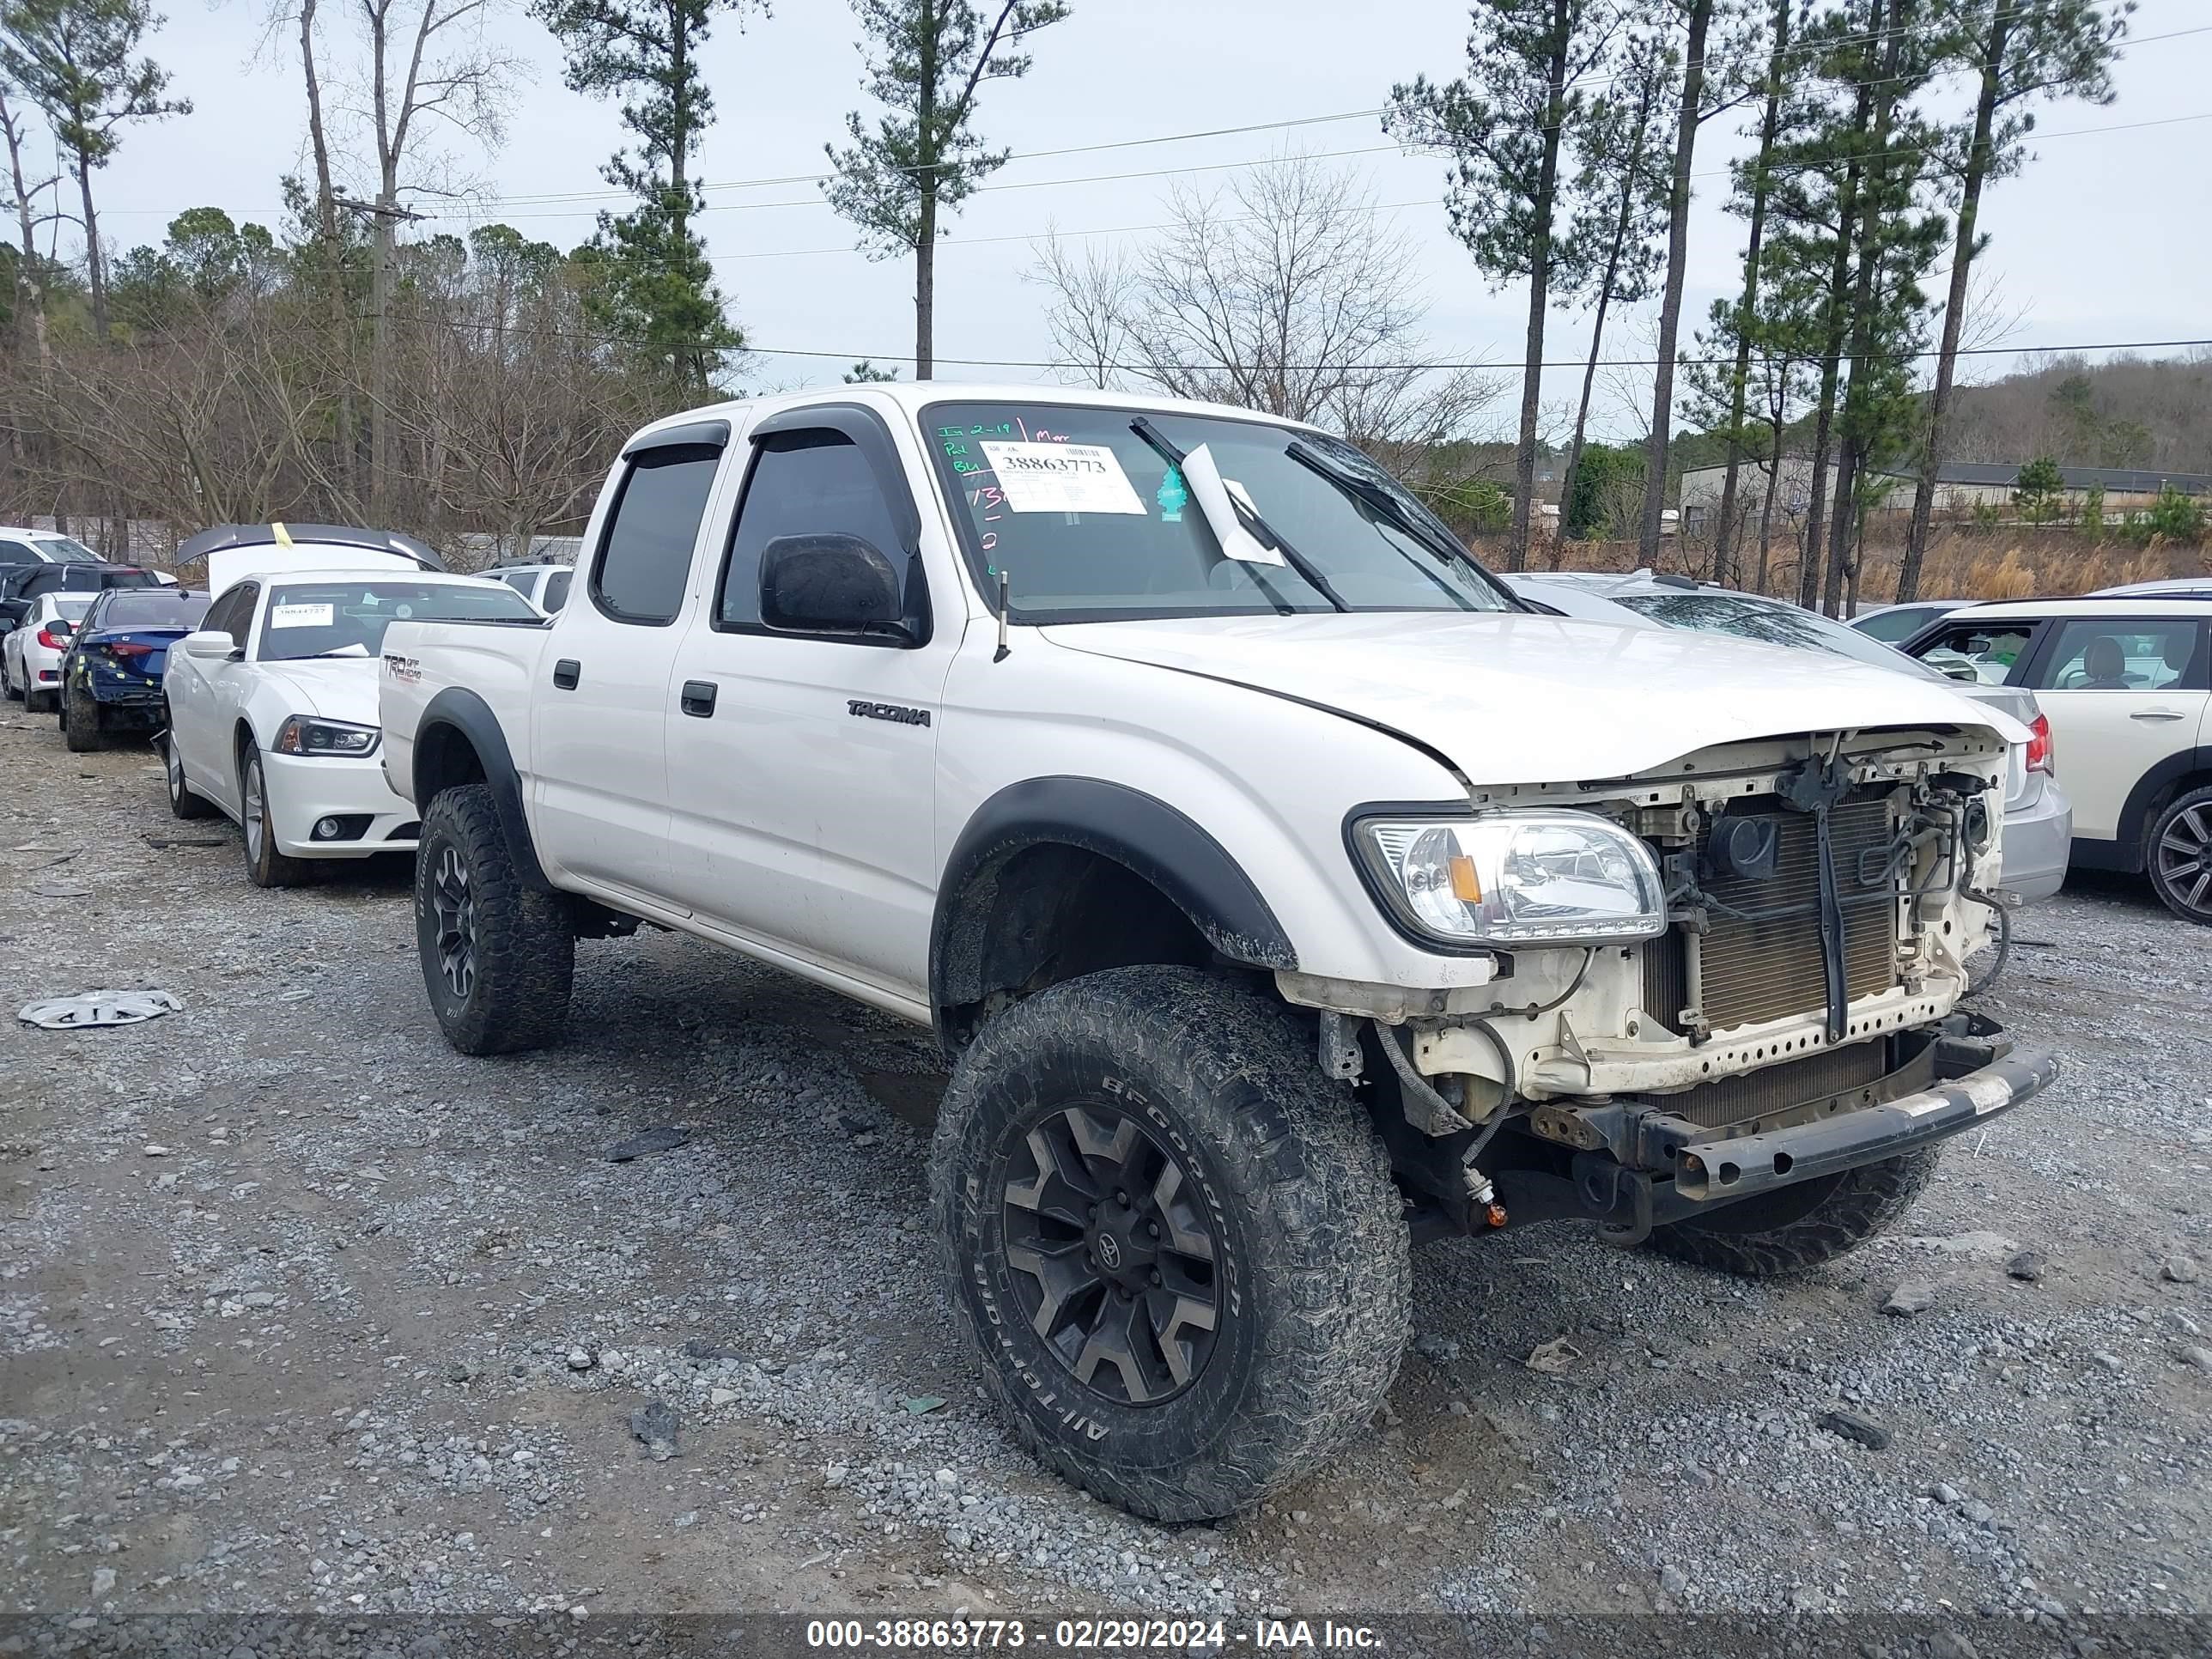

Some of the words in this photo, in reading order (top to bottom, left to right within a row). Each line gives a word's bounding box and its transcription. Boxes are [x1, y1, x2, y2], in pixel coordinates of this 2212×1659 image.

[970, 423, 1011, 434] 2-19
[1002, 456, 1107, 473] 38863773
[384, 654, 405, 680] TRD
[847, 699, 931, 728] TACOMA
